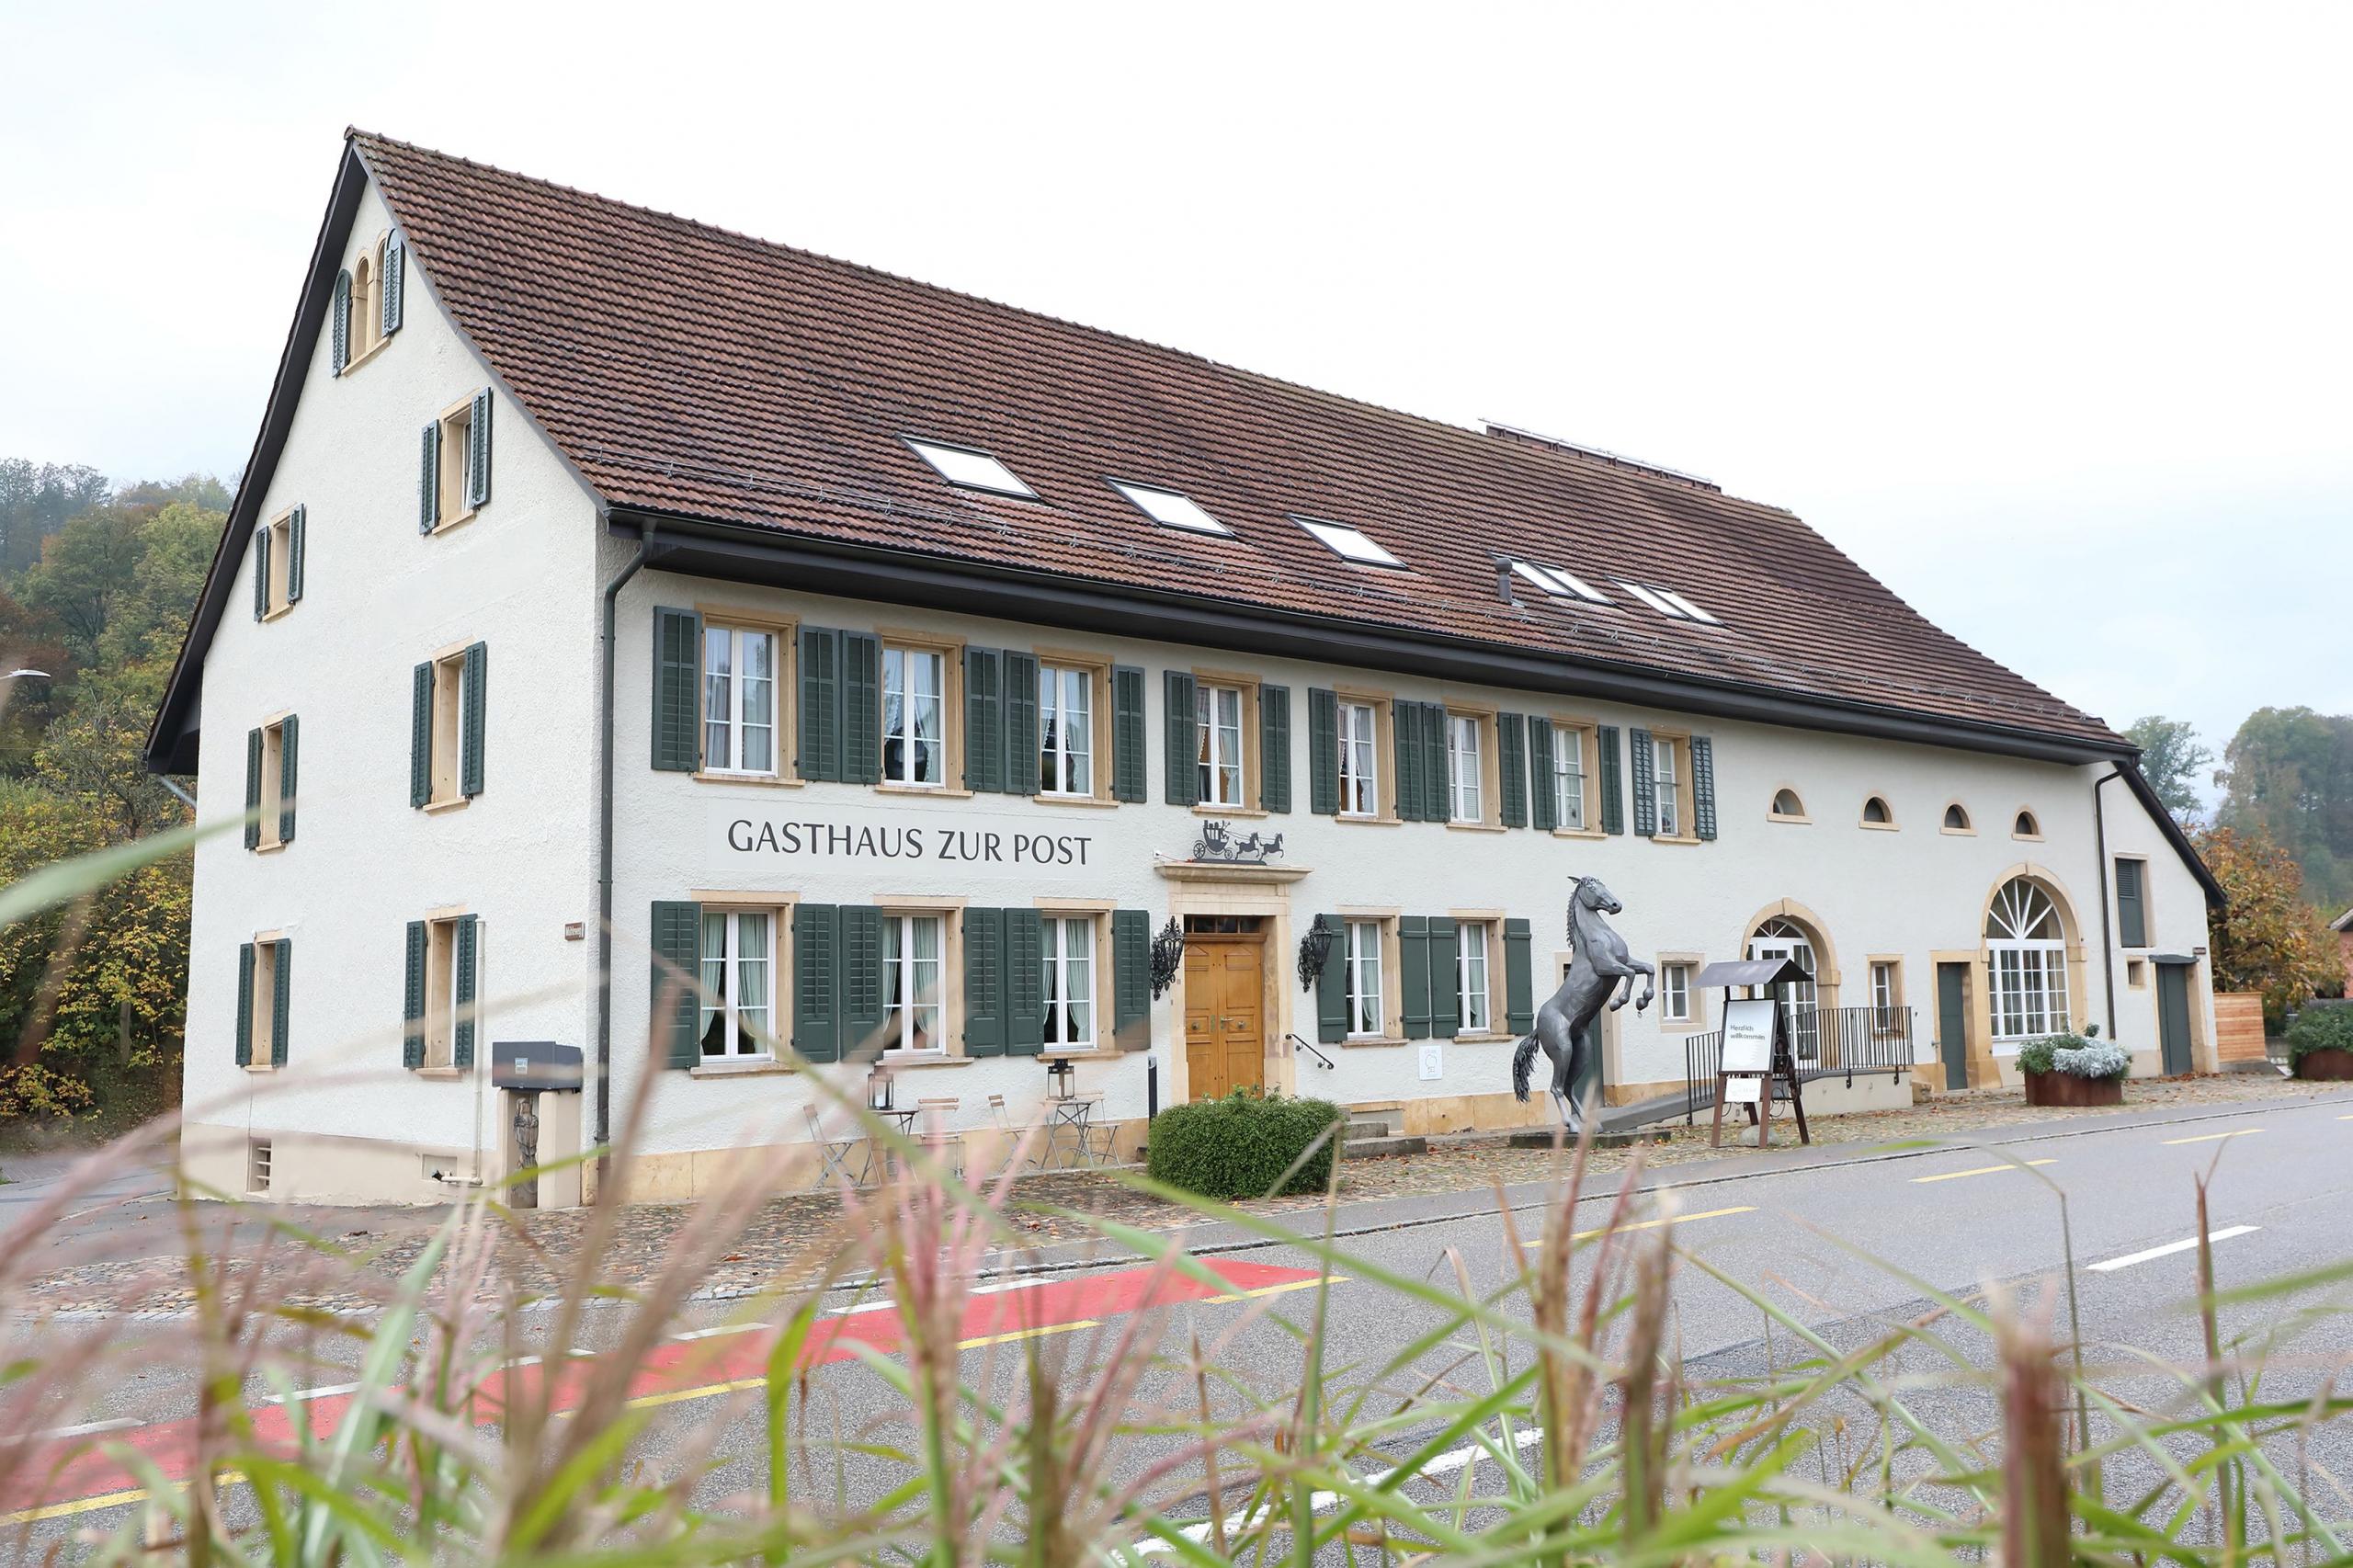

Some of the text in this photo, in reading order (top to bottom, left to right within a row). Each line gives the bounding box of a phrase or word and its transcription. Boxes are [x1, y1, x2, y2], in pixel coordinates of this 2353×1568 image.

[727, 820, 1093, 866] GASTHAUS ZUR POST
[1730, 1024, 1754, 1032] Herzlich
[1730, 1032, 1766, 1040] willkommen
